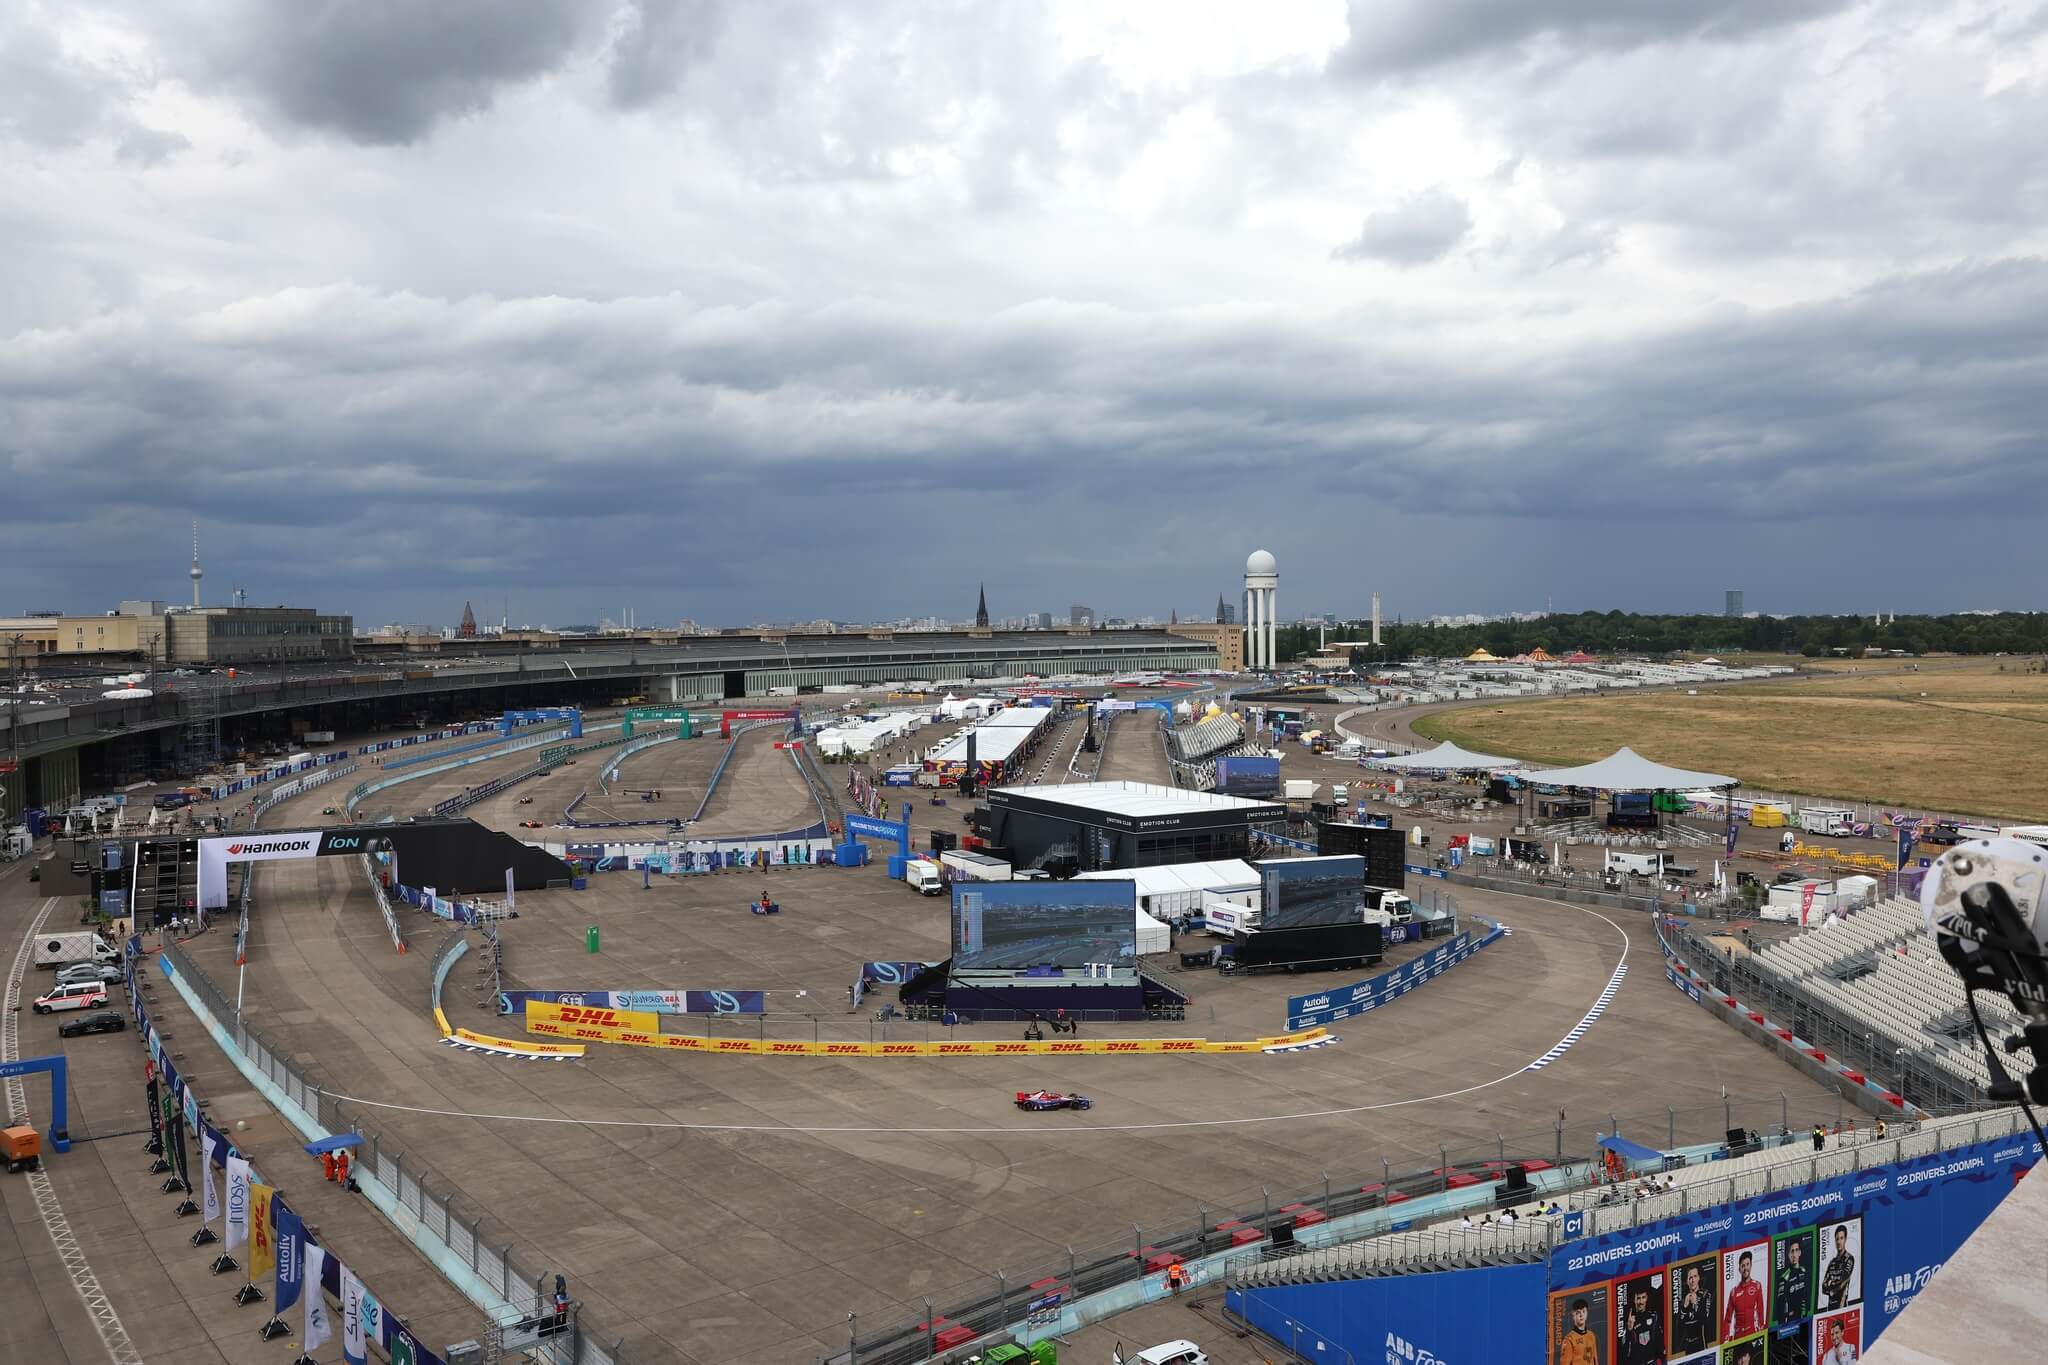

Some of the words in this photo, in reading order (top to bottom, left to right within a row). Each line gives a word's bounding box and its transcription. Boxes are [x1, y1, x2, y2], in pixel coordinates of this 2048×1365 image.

[1246, 811, 1269, 820] EMOTION
[1140, 818, 1165, 829] EMOTION
[1352, 983, 1372, 997] Autoliv
[1303, 995, 1330, 1009] Autoliv
[560, 1006, 621, 1028] DHL
[534, 1023, 560, 1034] DHL
[575, 1028, 604, 1040] DHL
[621, 1033, 650, 1044] DHL
[668, 1038, 700, 1048] DHL
[718, 1040, 752, 1050] DHL
[772, 1043, 806, 1052] DHL
[826, 1044, 861, 1053] DHL
[882, 1045, 916, 1053] DHL
[939, 1044, 973, 1053] DHL
[994, 1044, 1029, 1052] DHL
[1050, 1043, 1084, 1052] DHL
[1106, 1042, 1140, 1051] DHL
[1162, 1042, 1196, 1050] DHL
[1896, 1175, 1909, 1187] 22
[1909, 1166, 1947, 1184] DRIVERS.
[1948, 1156, 1985, 1174] 200MPH.
[228, 1174, 245, 1224] Infosys
[1743, 1212, 1757, 1225] 22
[1758, 1202, 1800, 1222] DRIVERS.
[1801, 1191, 1844, 1210] 200MPH.
[255, 1196, 268, 1249] DHL
[1566, 1218, 1581, 1232] C1
[1568, 1257, 1584, 1271] 22
[1584, 1245, 1635, 1267] DRIVERS.
[1635, 1232, 1683, 1254] 200MPH.
[279, 1234, 291, 1282] Autoliv
[1884, 1273, 1912, 1297] ABB
[1617, 1284, 1625, 1338] WEHRLEIN
[1385, 1331, 1414, 1361] ABB
